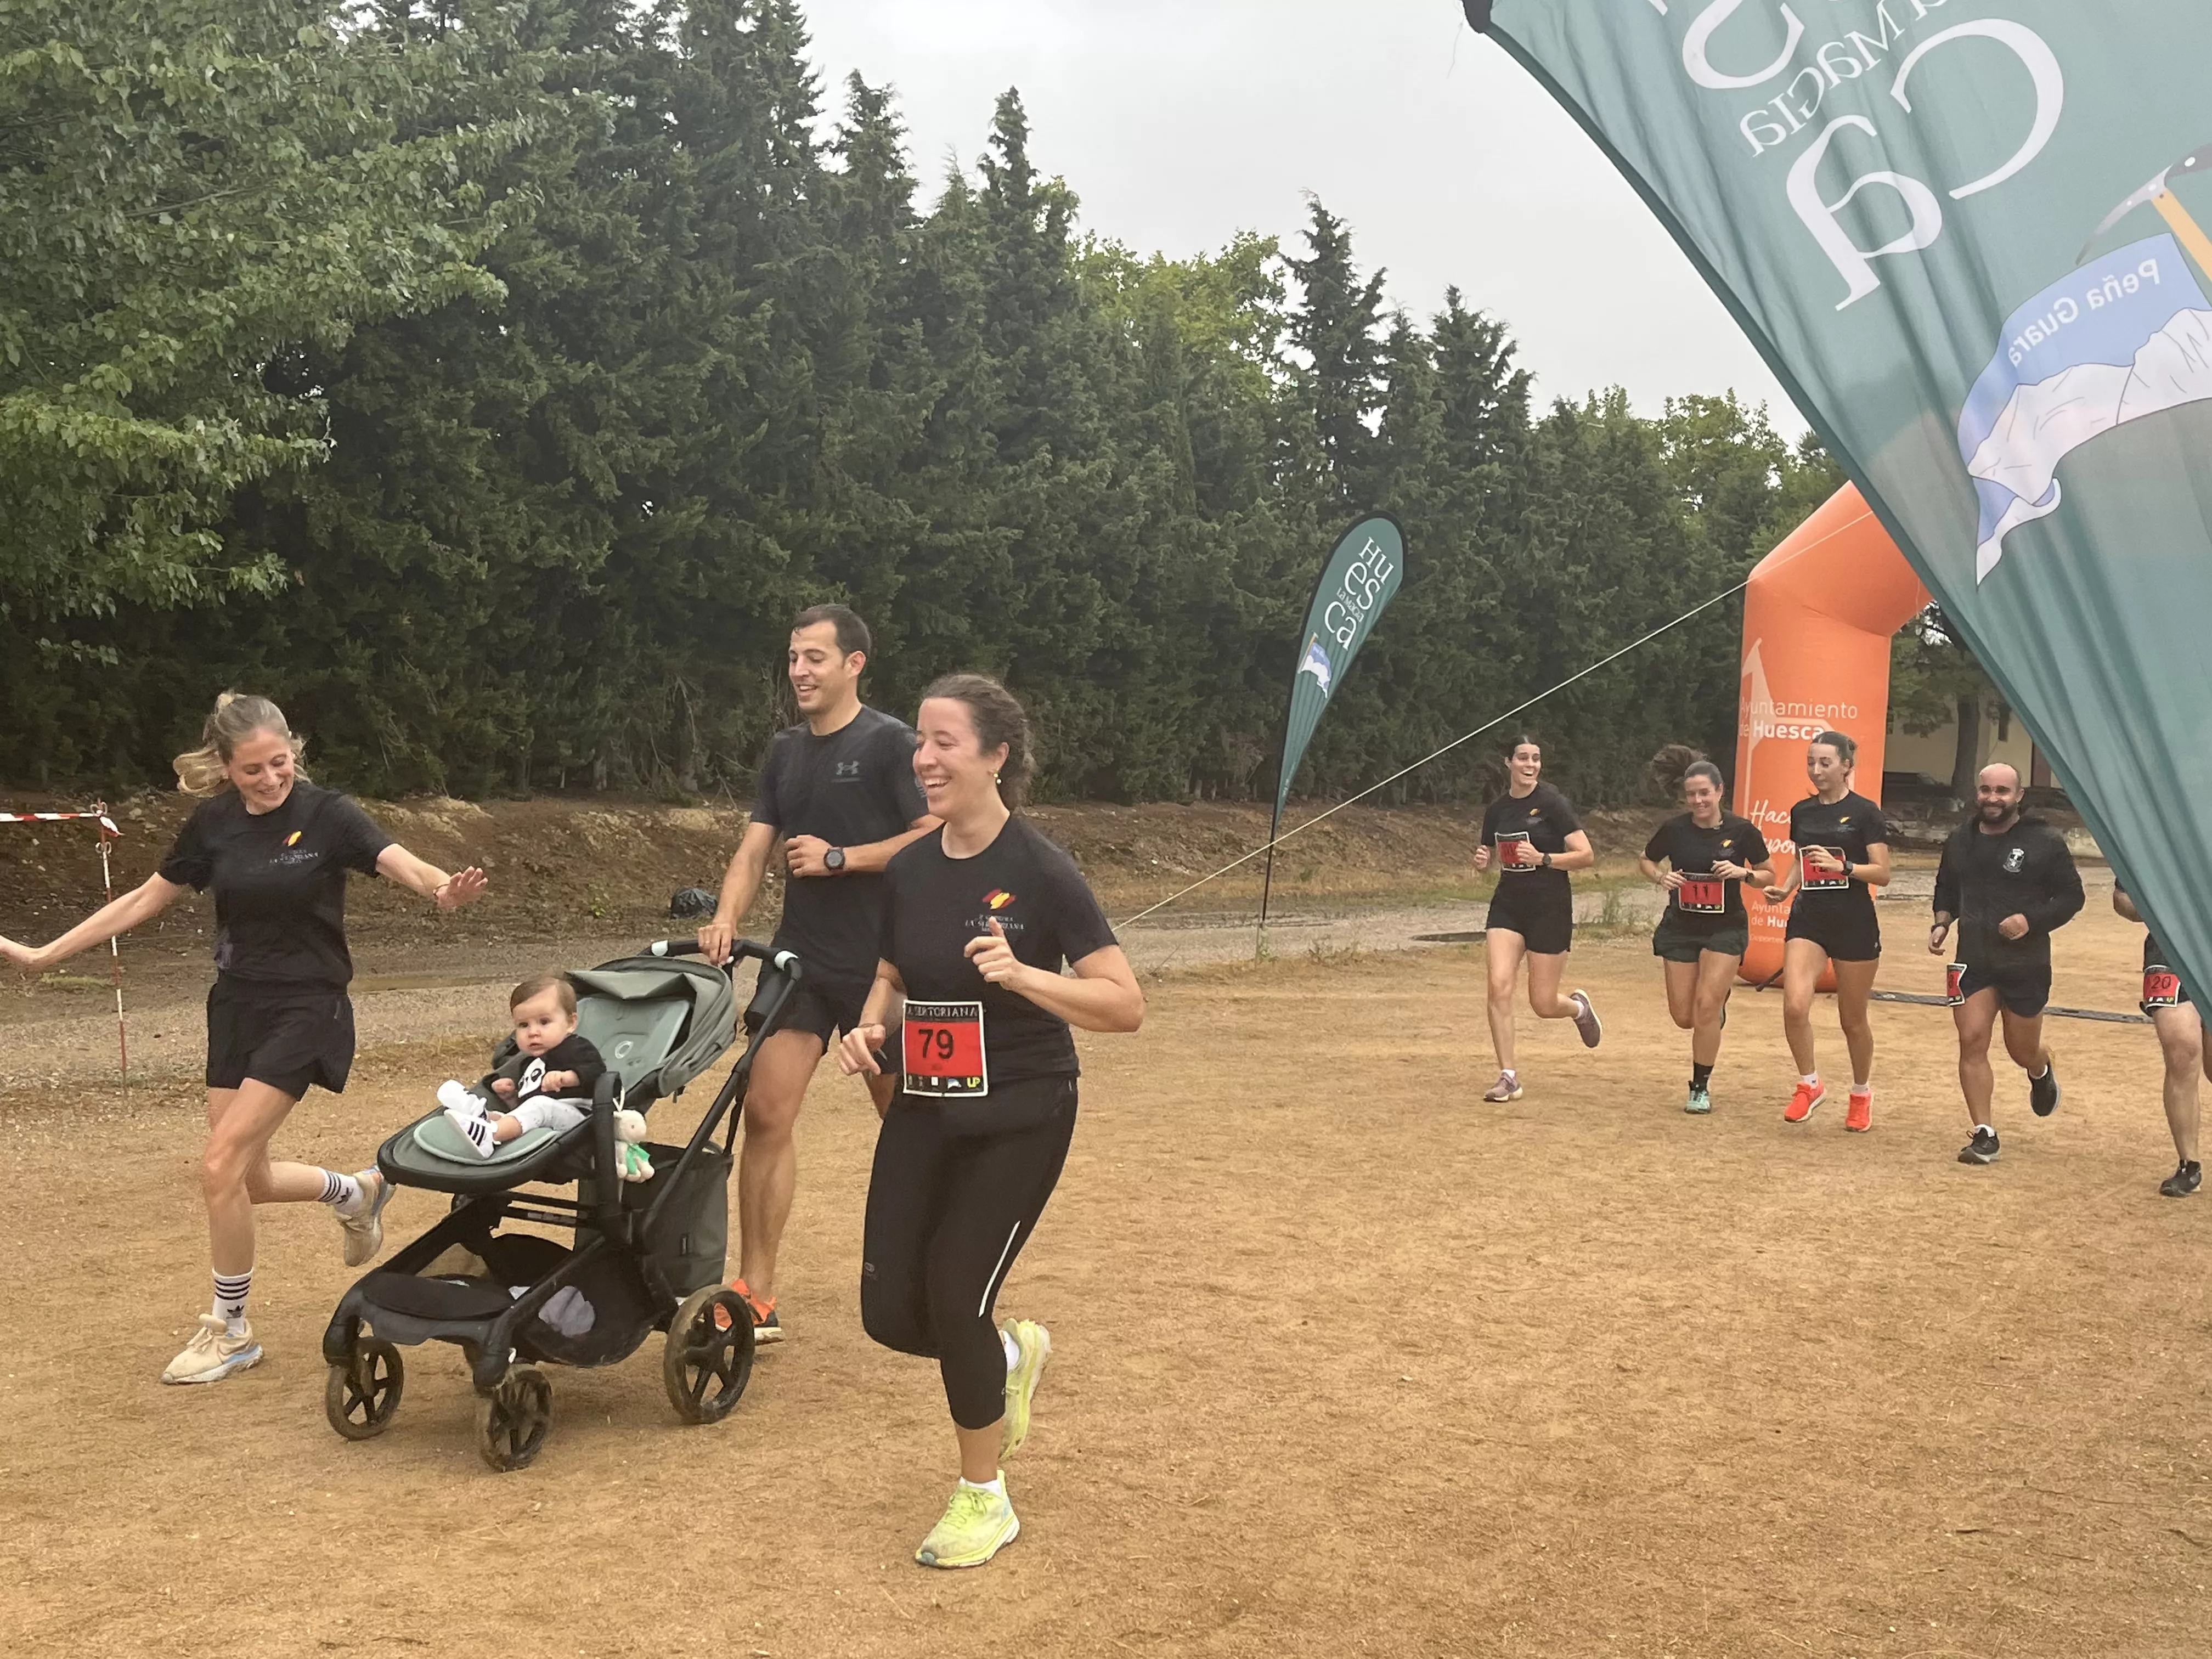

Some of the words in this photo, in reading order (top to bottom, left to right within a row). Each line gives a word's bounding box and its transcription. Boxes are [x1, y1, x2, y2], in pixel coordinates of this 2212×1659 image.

[1740, 696, 1858, 719] Ayuntamiento
[1750, 799, 1791, 831] Hac
[1751, 915, 1764, 926] de
[2151, 975, 2171, 989] 20
[918, 1029, 954, 1060] 79
